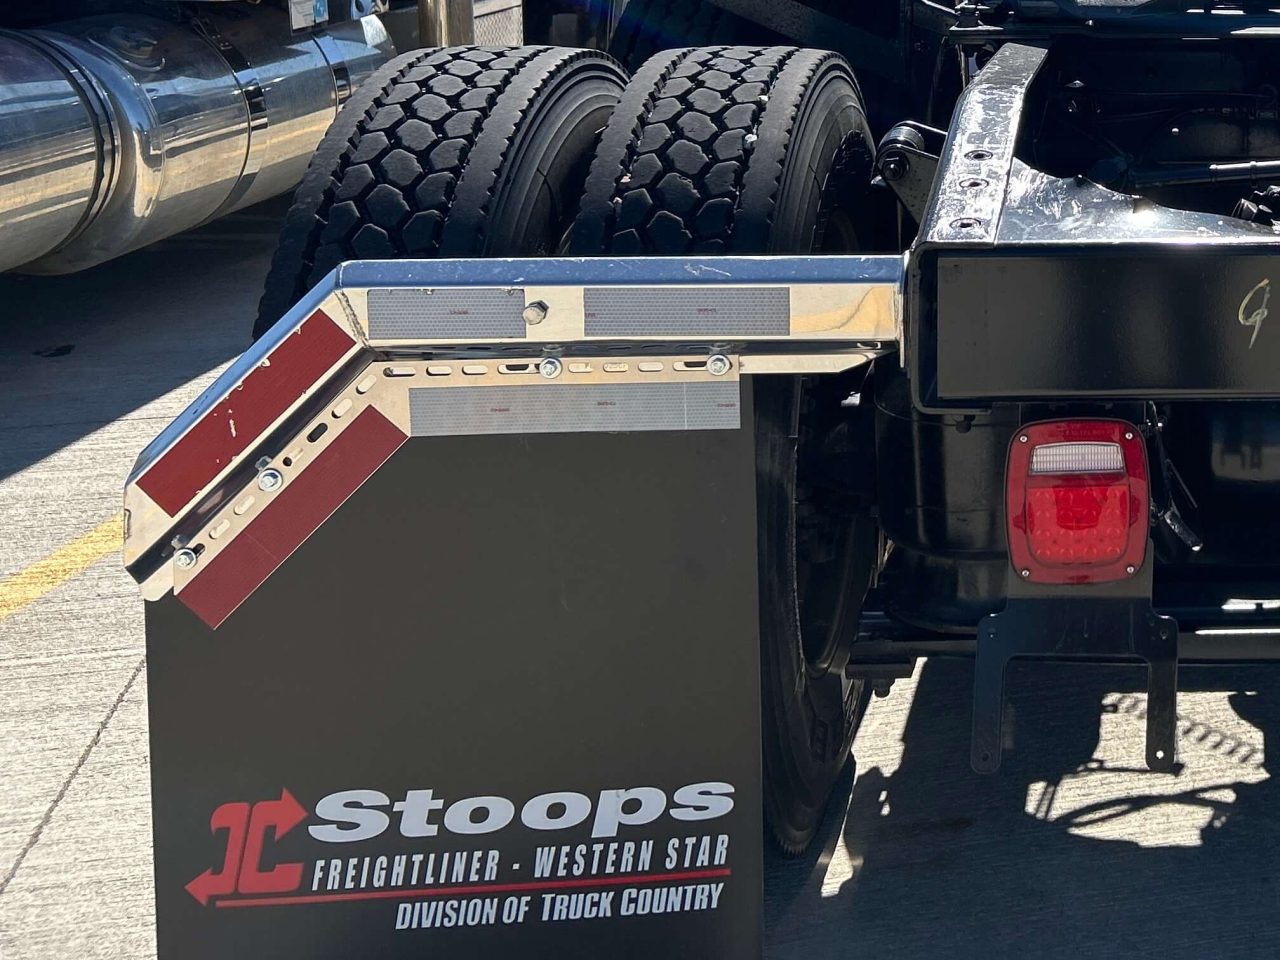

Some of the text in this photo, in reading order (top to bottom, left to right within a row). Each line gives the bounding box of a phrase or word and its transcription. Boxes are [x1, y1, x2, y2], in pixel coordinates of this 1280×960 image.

[307, 781, 735, 843] Stoops
[311, 849, 500, 891] FREIGHTLINER
[534, 839, 654, 878] WESTERN
[665, 834, 729, 870] STAR
[395, 882, 725, 930] DIVISION OF TRUCK COUNTRY
